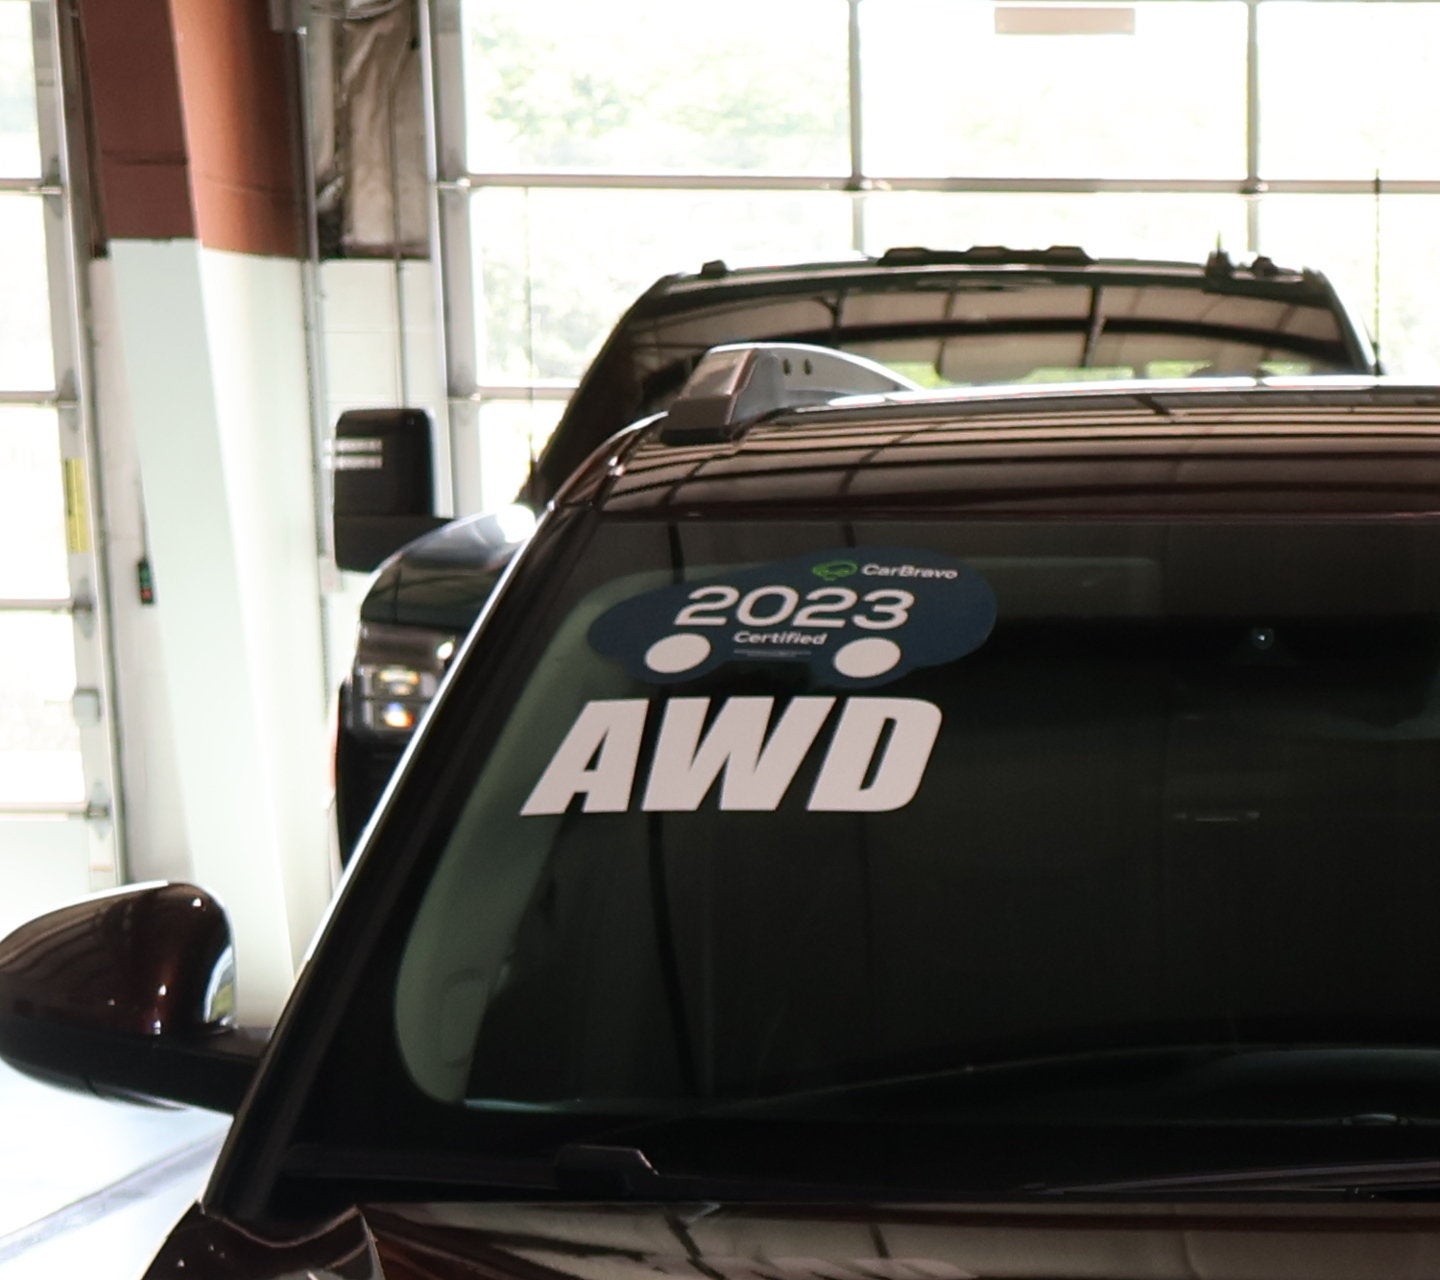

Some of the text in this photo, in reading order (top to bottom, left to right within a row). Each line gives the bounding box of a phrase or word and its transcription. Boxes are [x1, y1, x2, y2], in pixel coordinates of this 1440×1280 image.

[861, 563, 959, 580] CarBravo
[673, 584, 916, 631] 2023
[732, 630, 828, 646] Certified
[520, 695, 944, 816] AWD
